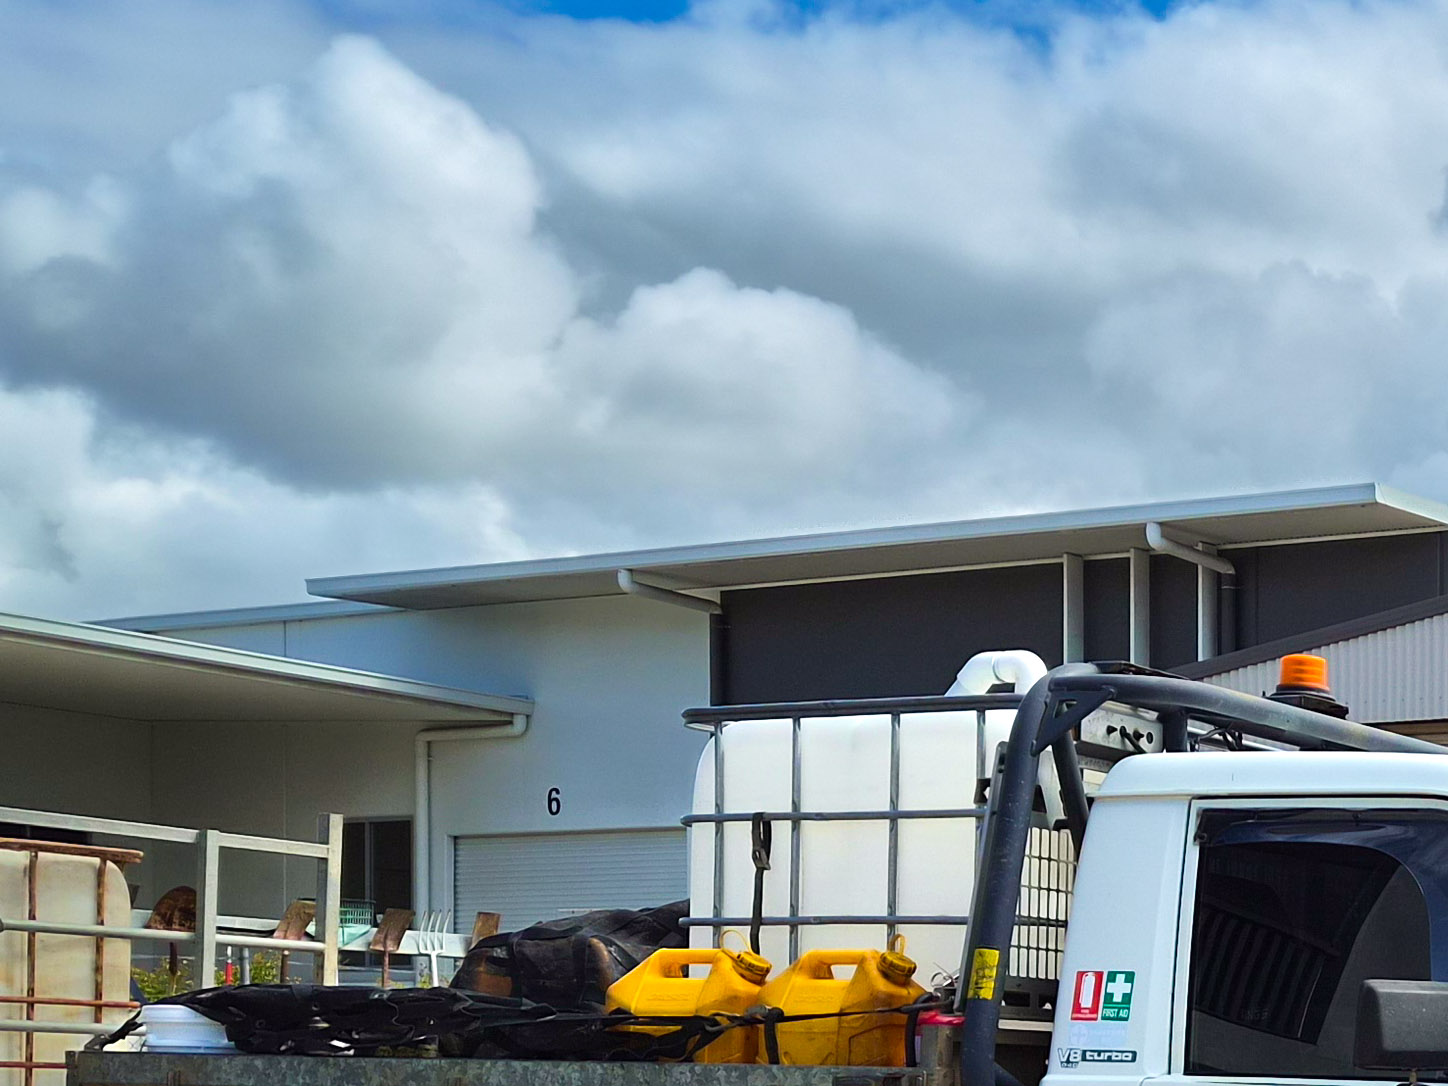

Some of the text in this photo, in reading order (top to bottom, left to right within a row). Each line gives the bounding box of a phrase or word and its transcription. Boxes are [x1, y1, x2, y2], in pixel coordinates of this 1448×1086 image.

[548, 787, 561, 816] 6
[1102, 1008, 1118, 1018] FIRST
[1118, 1008, 1129, 1018] AID
[1058, 1048, 1133, 1062] V8 turbo
